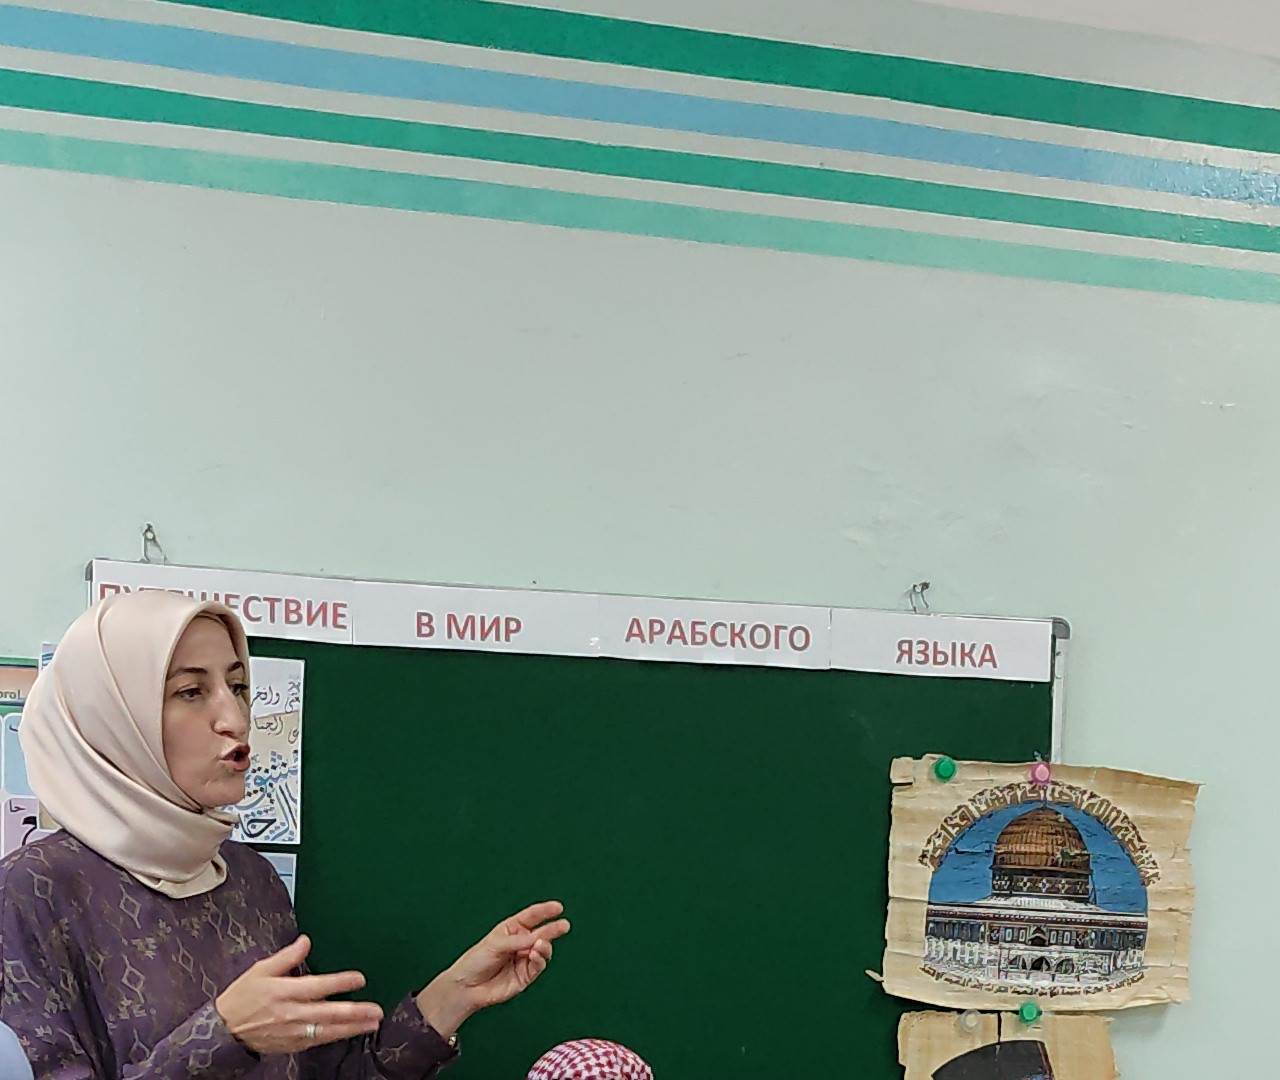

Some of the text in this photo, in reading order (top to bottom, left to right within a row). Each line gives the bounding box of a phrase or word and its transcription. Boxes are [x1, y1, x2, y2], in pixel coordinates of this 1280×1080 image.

[99, 583, 999, 669] ПЕСТВИЕ В МИР АРАБСКОГО ЯЗЫКА
